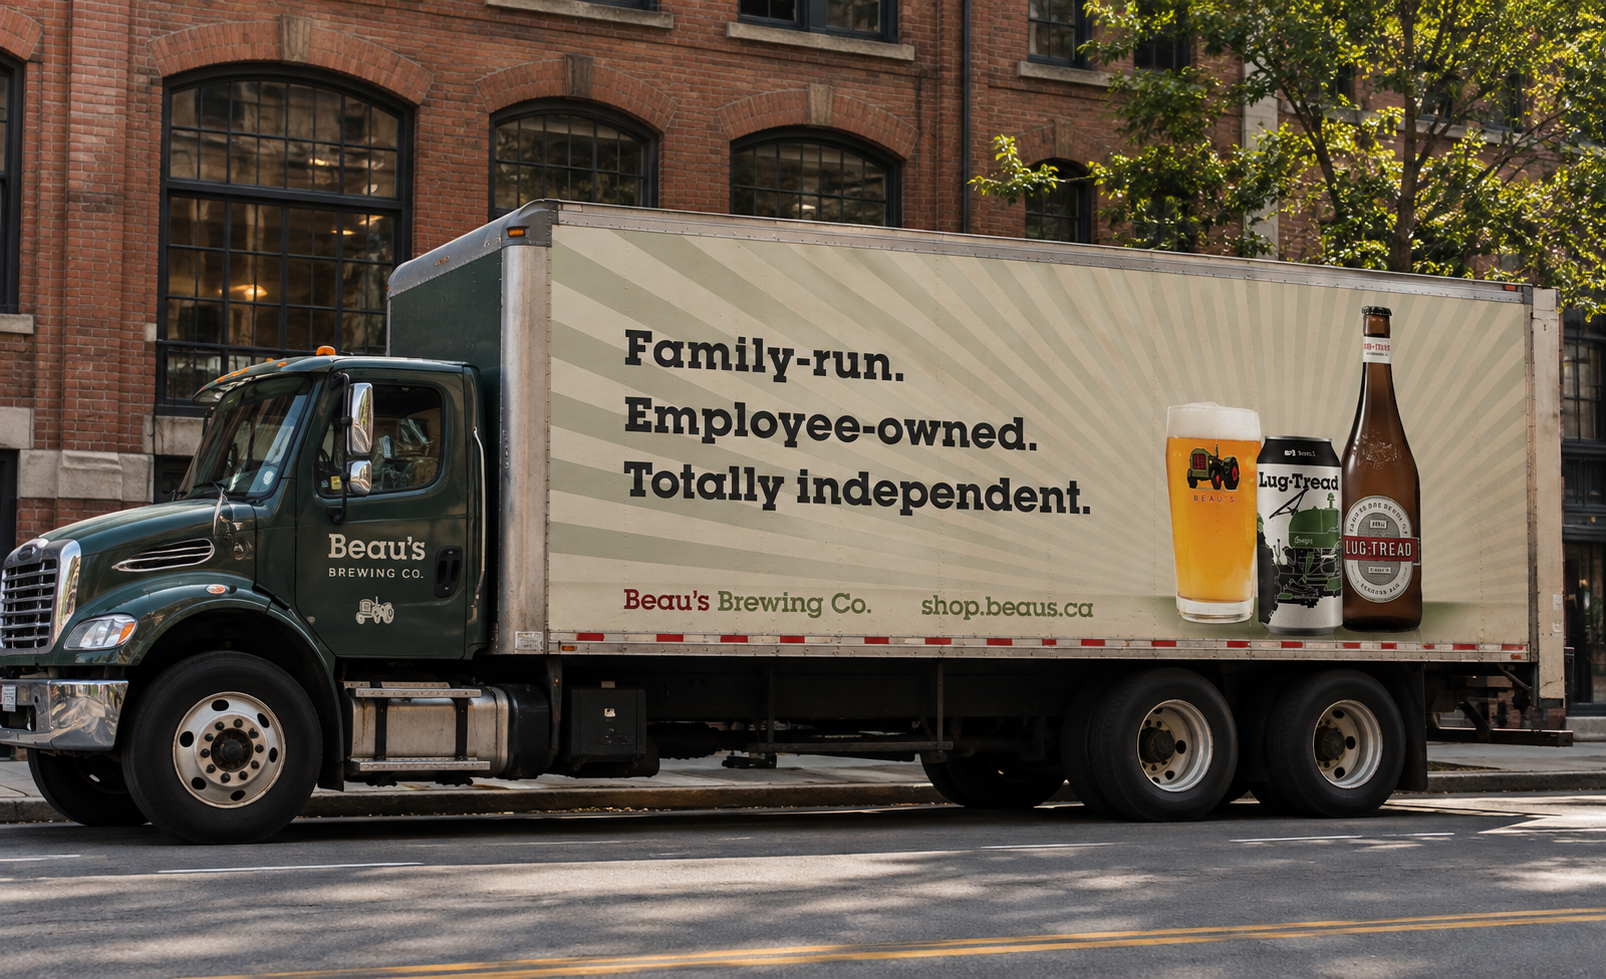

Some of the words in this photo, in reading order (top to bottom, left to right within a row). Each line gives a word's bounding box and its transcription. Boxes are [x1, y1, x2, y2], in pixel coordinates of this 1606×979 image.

[625, 329, 904, 383] Family-run.
[625, 396, 1037, 450] Employee-owned.
[624, 461, 784, 510] Totally
[797, 469, 1091, 516] independent.
[328, 533, 426, 560] Beau's
[328, 567, 396, 578] BREWING
[401, 568, 424, 579] CO.
[624, 589, 710, 612] Beau's
[717, 591, 824, 619] Brewing
[831, 594, 872, 614] Co.
[921, 595, 1094, 620] shop.beaus.ca
